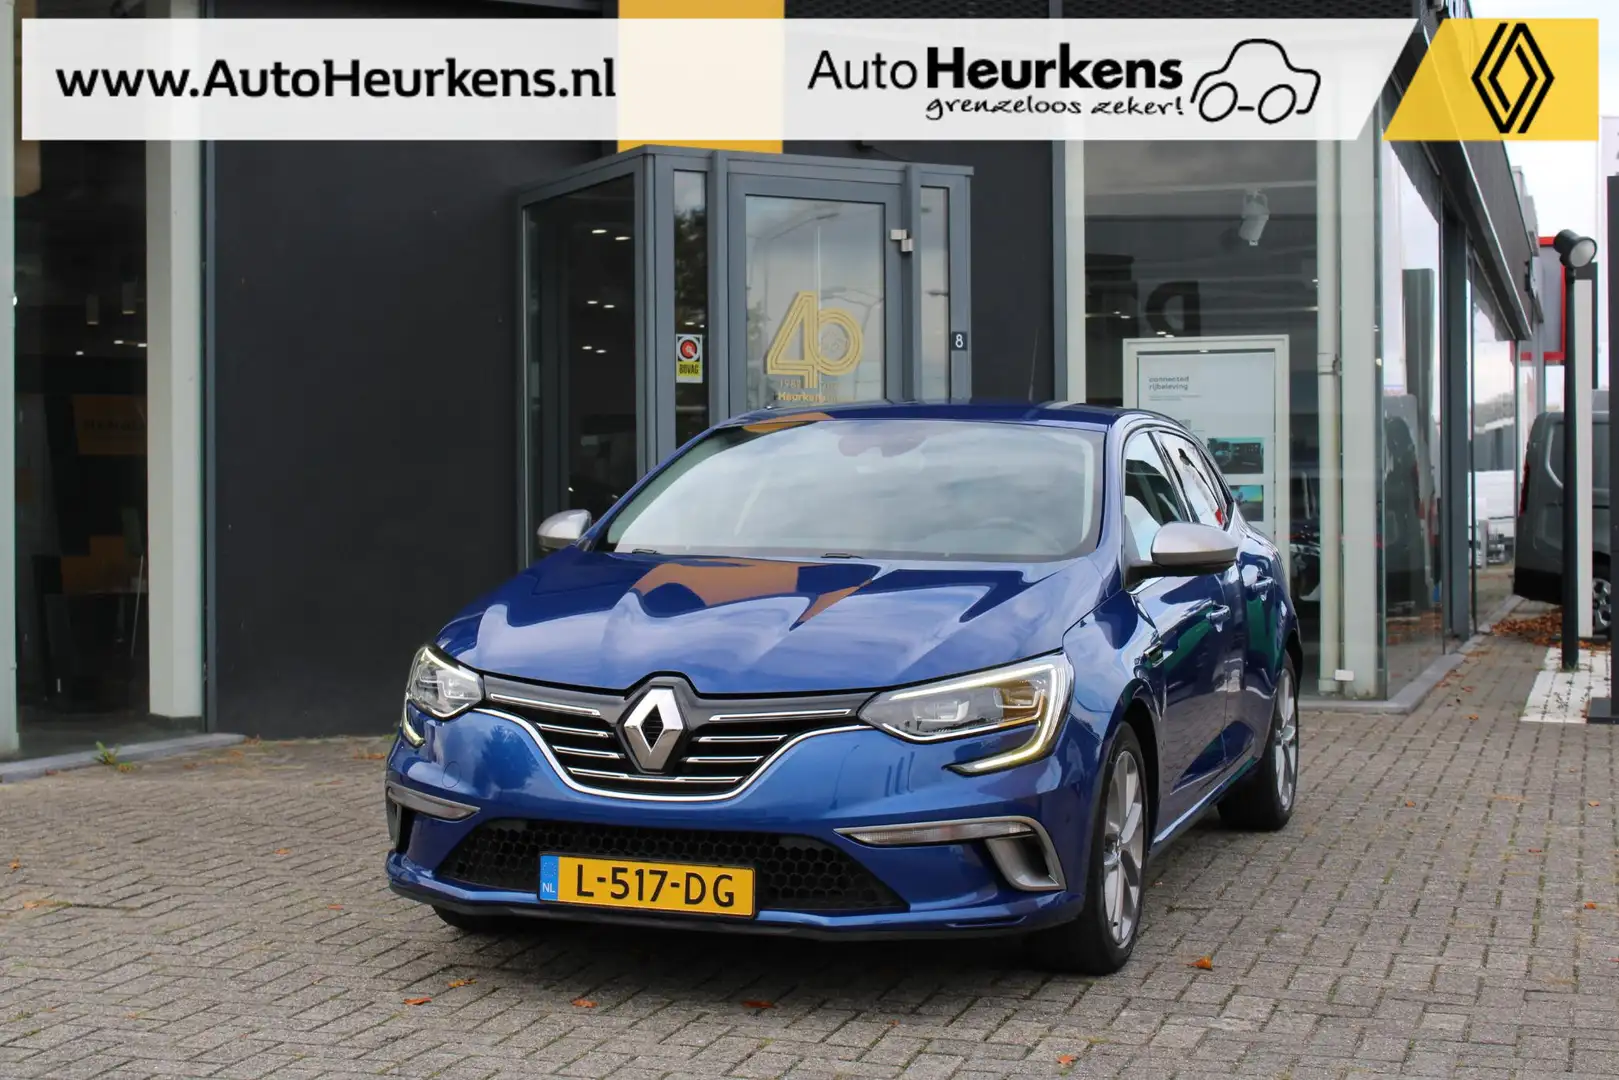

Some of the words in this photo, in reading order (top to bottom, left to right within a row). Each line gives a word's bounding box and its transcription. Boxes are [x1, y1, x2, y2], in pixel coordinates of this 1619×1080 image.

[767, 290, 863, 389] 40
[955, 333, 964, 348] 8
[679, 364, 699, 374] BOVAG
[542, 882, 556, 893] NL
[576, 864, 735, 908] L-517-DG
